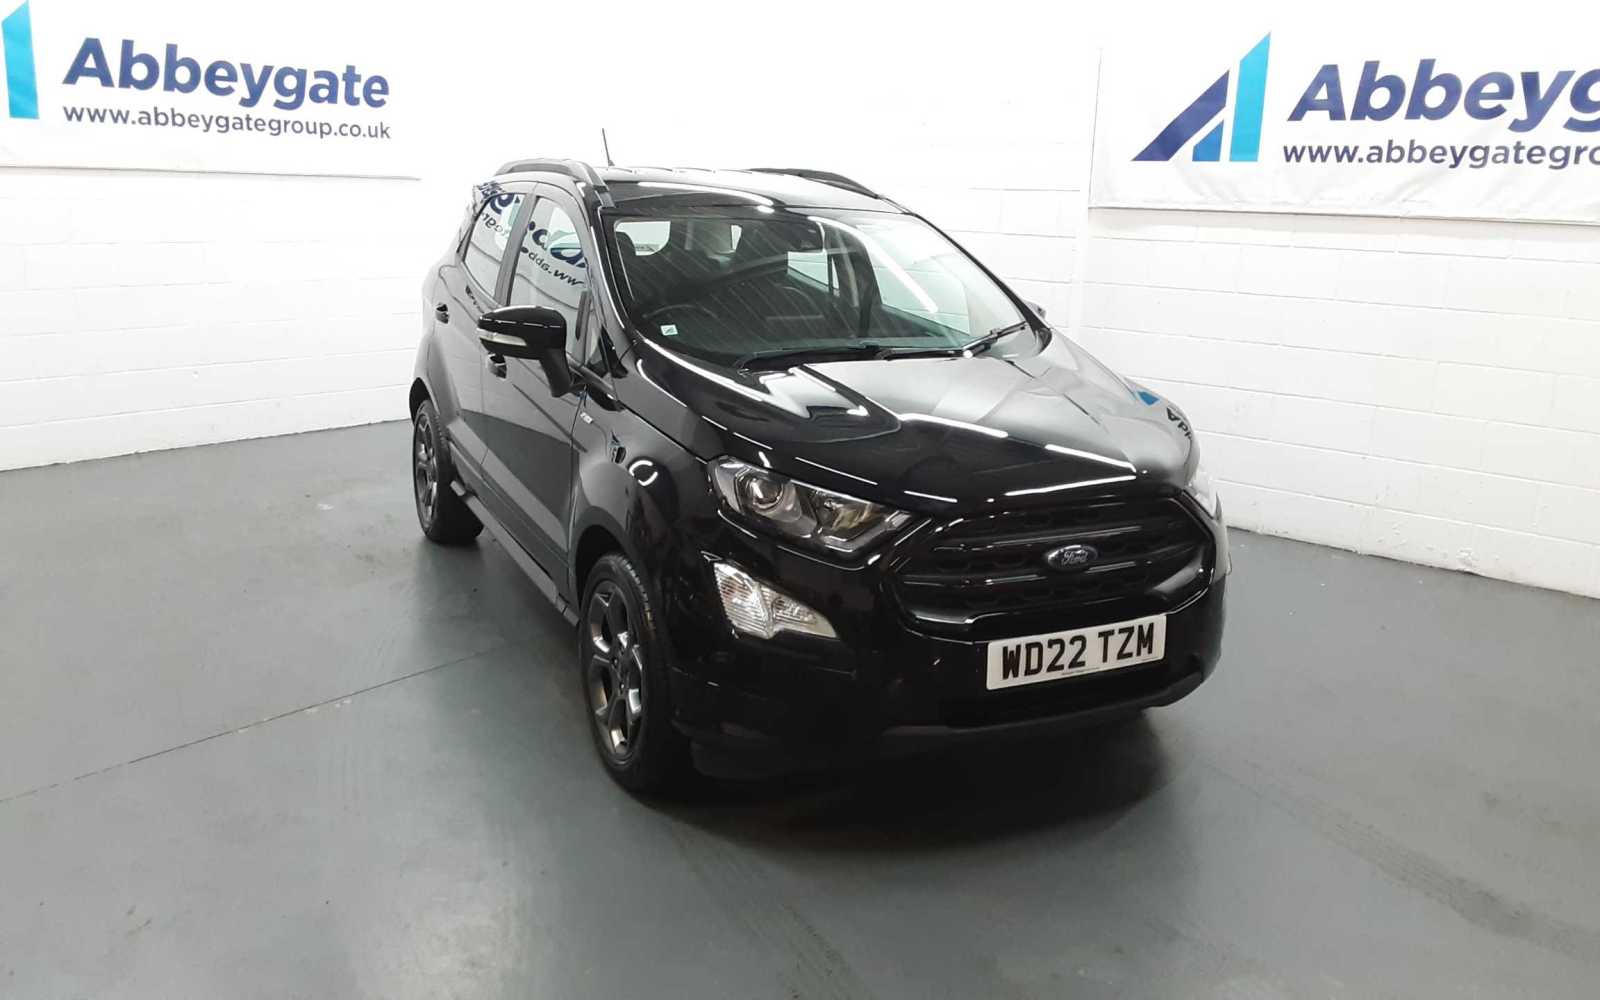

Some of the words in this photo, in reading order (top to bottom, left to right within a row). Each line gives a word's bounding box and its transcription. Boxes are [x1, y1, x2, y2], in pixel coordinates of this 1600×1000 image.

[62, 37, 390, 111] Abbeygate
[1287, 58, 1600, 133] Abbeyg
[63, 106, 391, 139] www.abbeygategroup.co.uk
[1061, 549, 1088, 566] Ford
[1002, 634, 1087, 680] WD22
[1098, 623, 1154, 663] TZM
